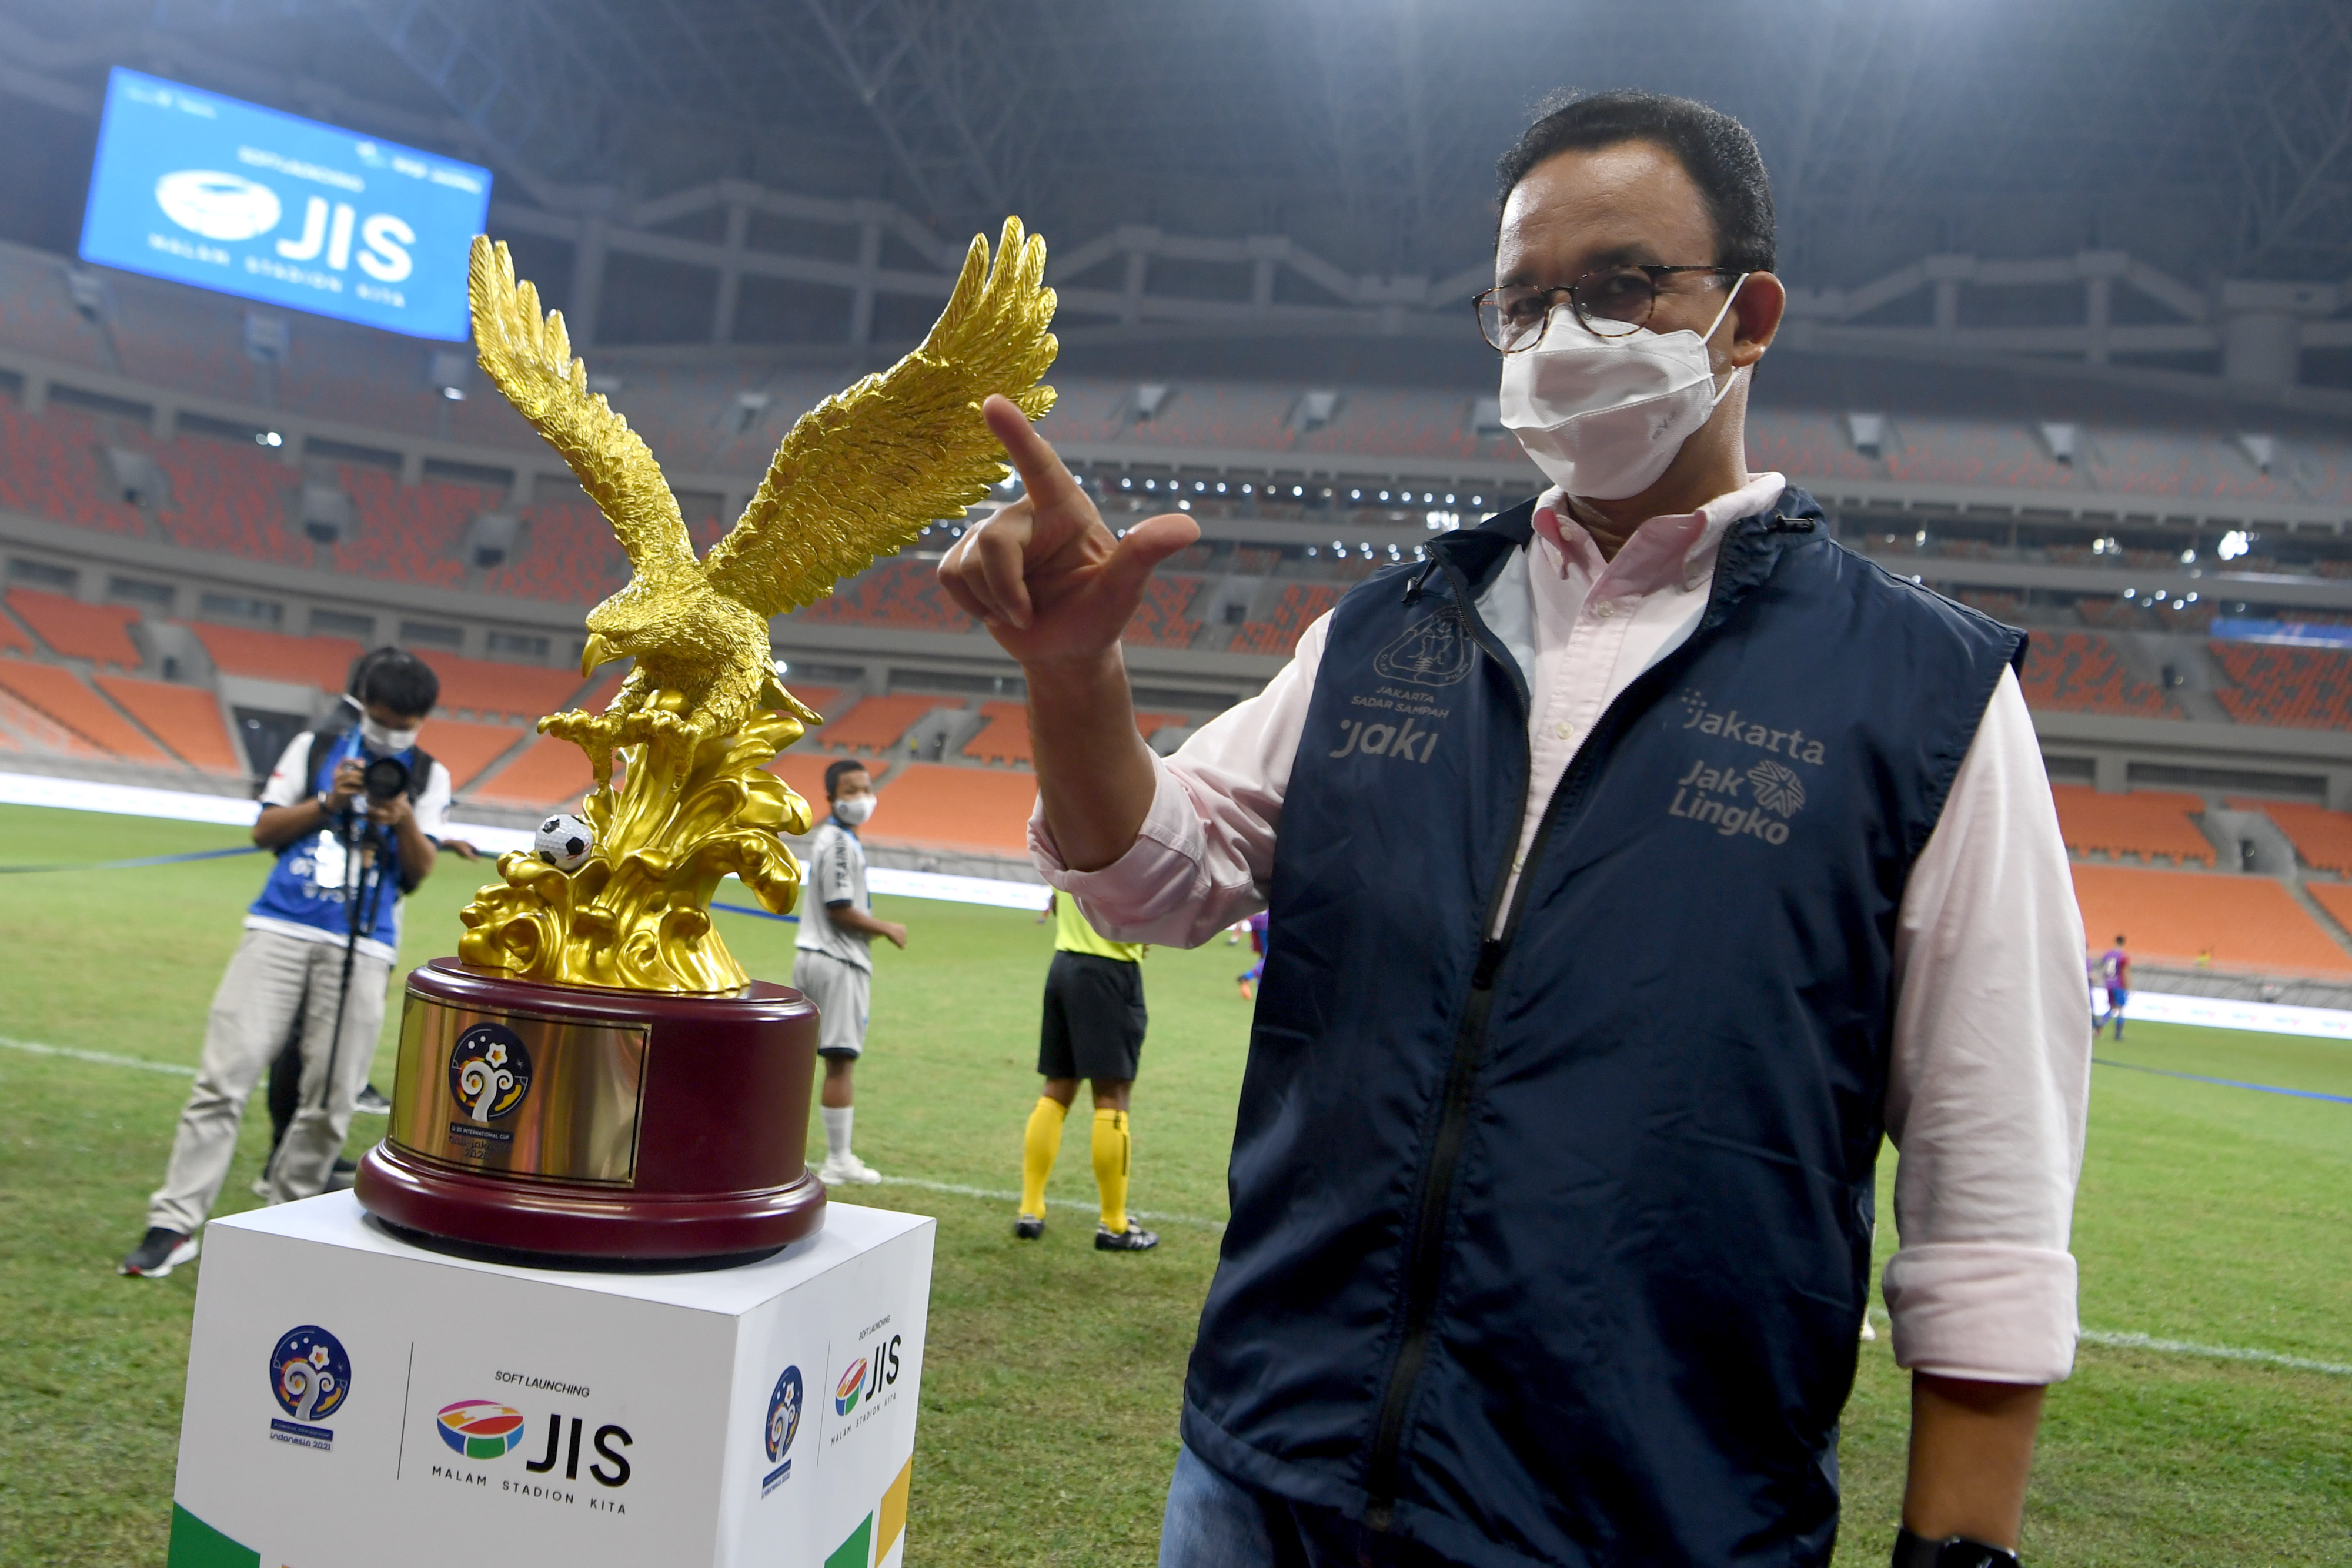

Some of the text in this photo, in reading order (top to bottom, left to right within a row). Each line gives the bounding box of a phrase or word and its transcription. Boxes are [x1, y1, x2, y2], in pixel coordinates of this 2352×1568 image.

[275, 195, 417, 283] JIS
[1351, 696, 1449, 719] SADAR SAMPAH
[1376, 686, 1434, 703] JAKARTA
[1329, 718, 1439, 764] jaki
[1679, 760, 1745, 796] Jak
[1669, 788, 1790, 845] Lingko
[463, 1128, 498, 1139] INTERNATIONAL
[495, 1371, 590, 1398] SOFT LAUNCHING
[866, 1334, 901, 1402] JIS
[831, 1392, 896, 1447] MALAM STADION KITA
[312, 1440, 330, 1451] 2021
[526, 1413, 633, 1489] JIS
[432, 1466, 626, 1514] MALAM STADION KITA
